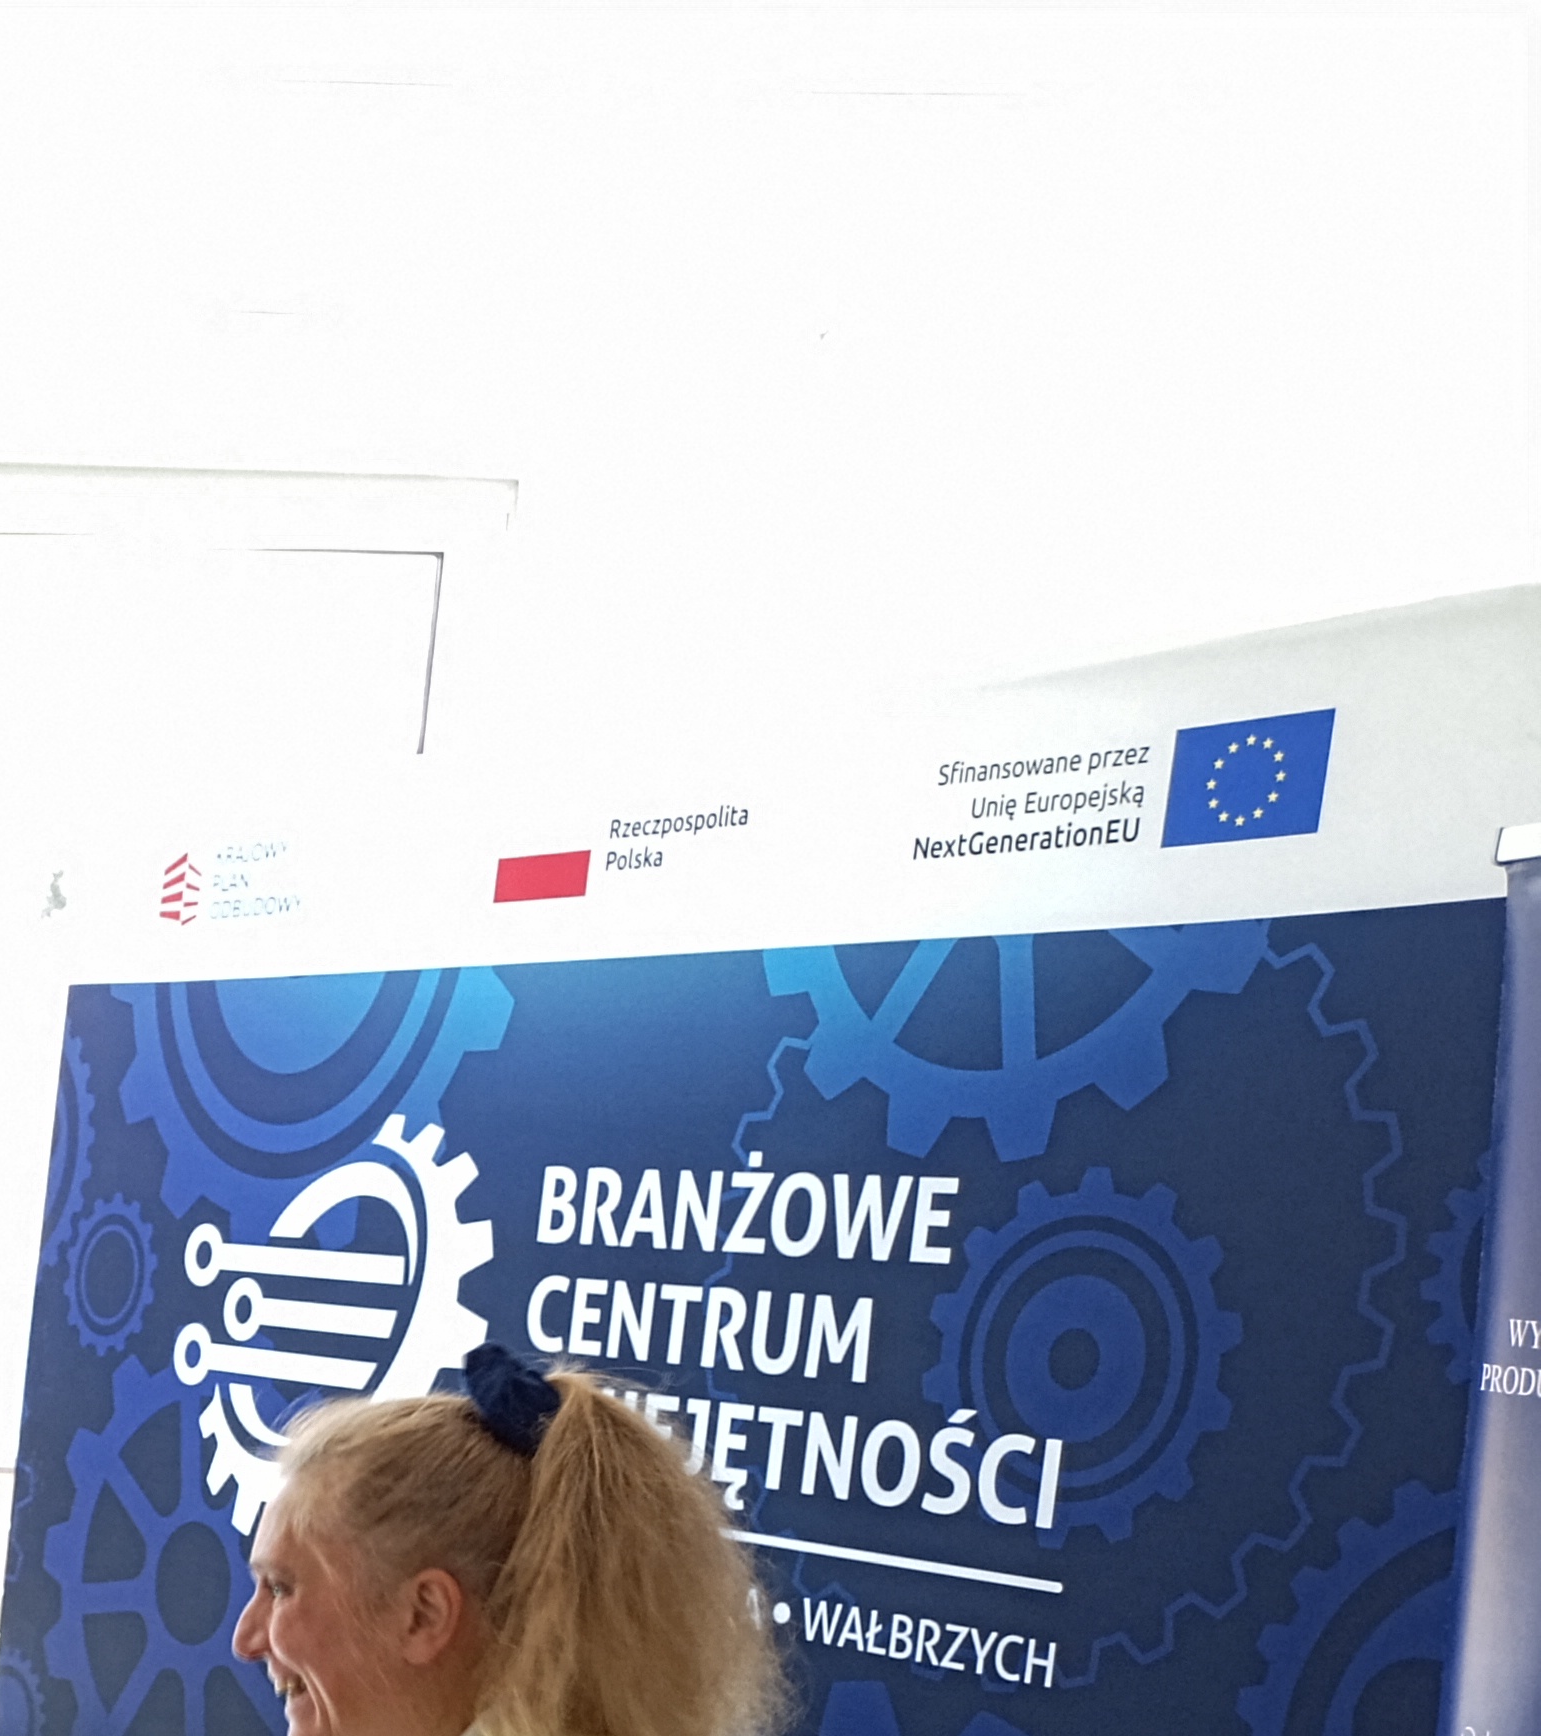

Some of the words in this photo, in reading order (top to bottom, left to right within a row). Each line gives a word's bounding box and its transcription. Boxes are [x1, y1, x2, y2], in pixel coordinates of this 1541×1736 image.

[937, 752, 1081, 787] Sfinansowane
[1087, 744, 1151, 775] przez
[609, 805, 749, 840] Rzeczpospolita
[970, 791, 1018, 822] Unię
[1023, 780, 1145, 817] Europejską
[605, 847, 664, 873] Polska
[912, 817, 1141, 860] NextGenerationEU
[536, 1151, 960, 1264] BRANŻOWE
[525, 1274, 874, 1383] CENTRUM
[601, 1388, 1064, 1530] EJĘTNOŚCI
[803, 1598, 1057, 1688] WAŁBRZYCH
